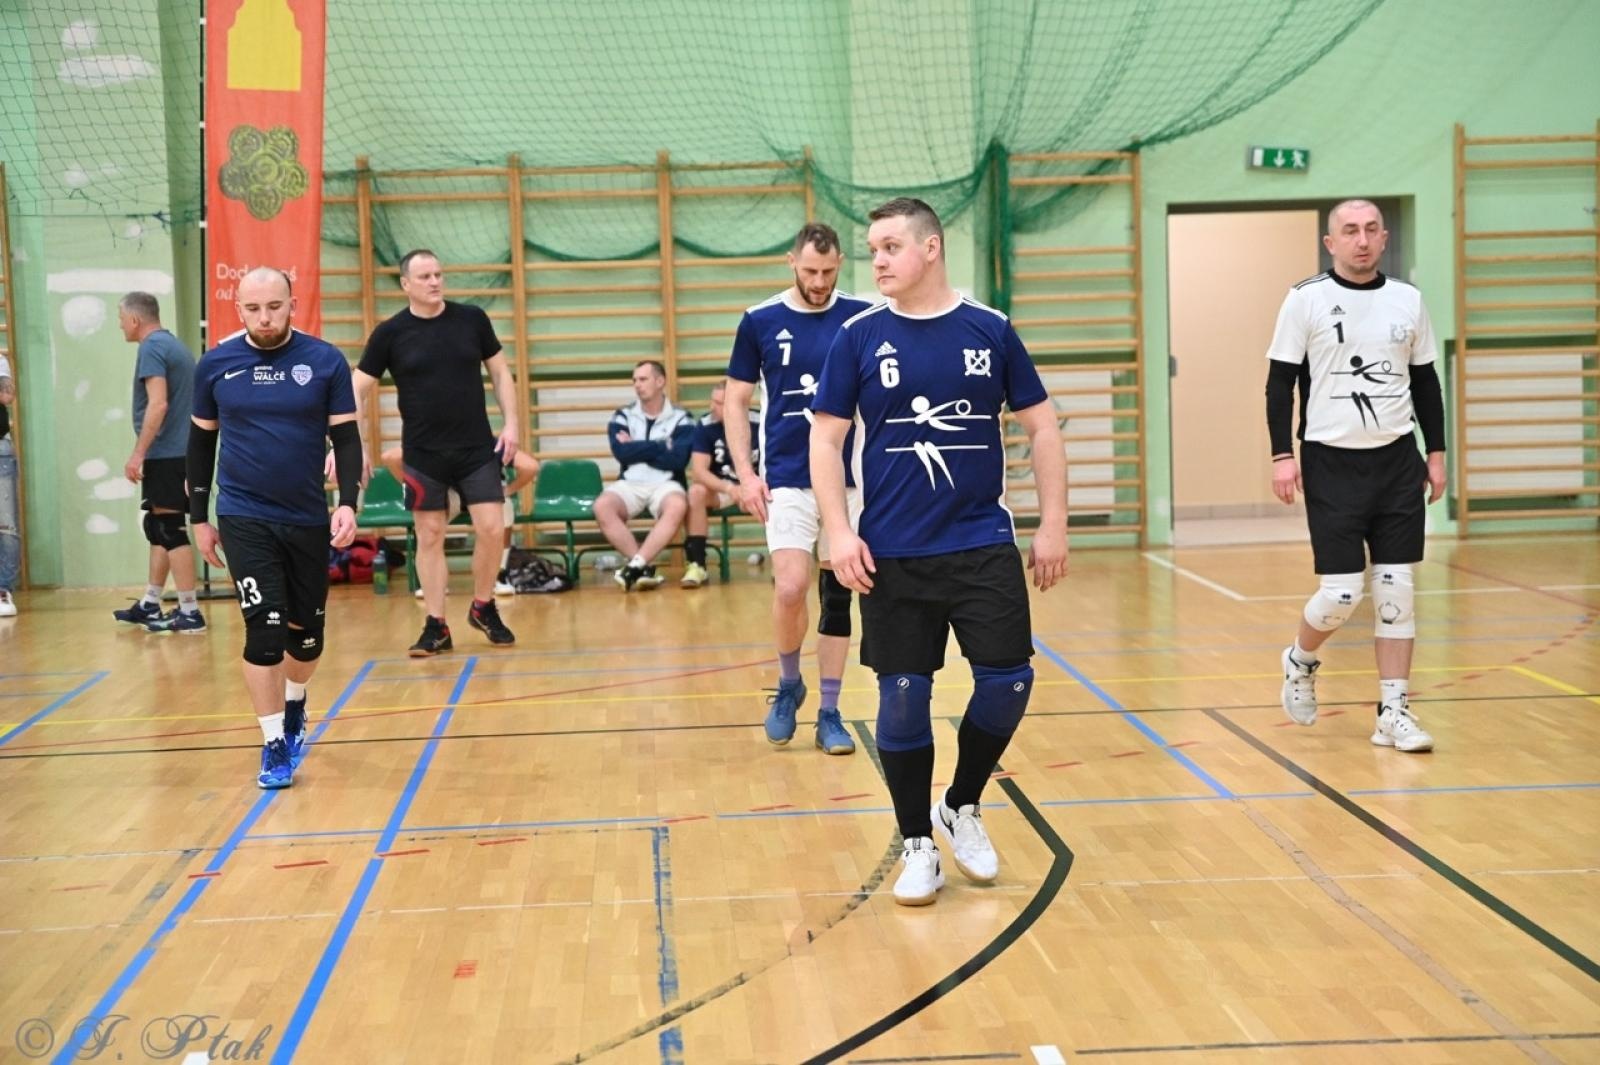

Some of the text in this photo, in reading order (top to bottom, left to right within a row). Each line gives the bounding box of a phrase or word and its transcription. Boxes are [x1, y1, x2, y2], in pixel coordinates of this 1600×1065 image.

[1333, 320, 1345, 344] 1
[778, 342, 791, 366] 7
[879, 357, 900, 389] 6
